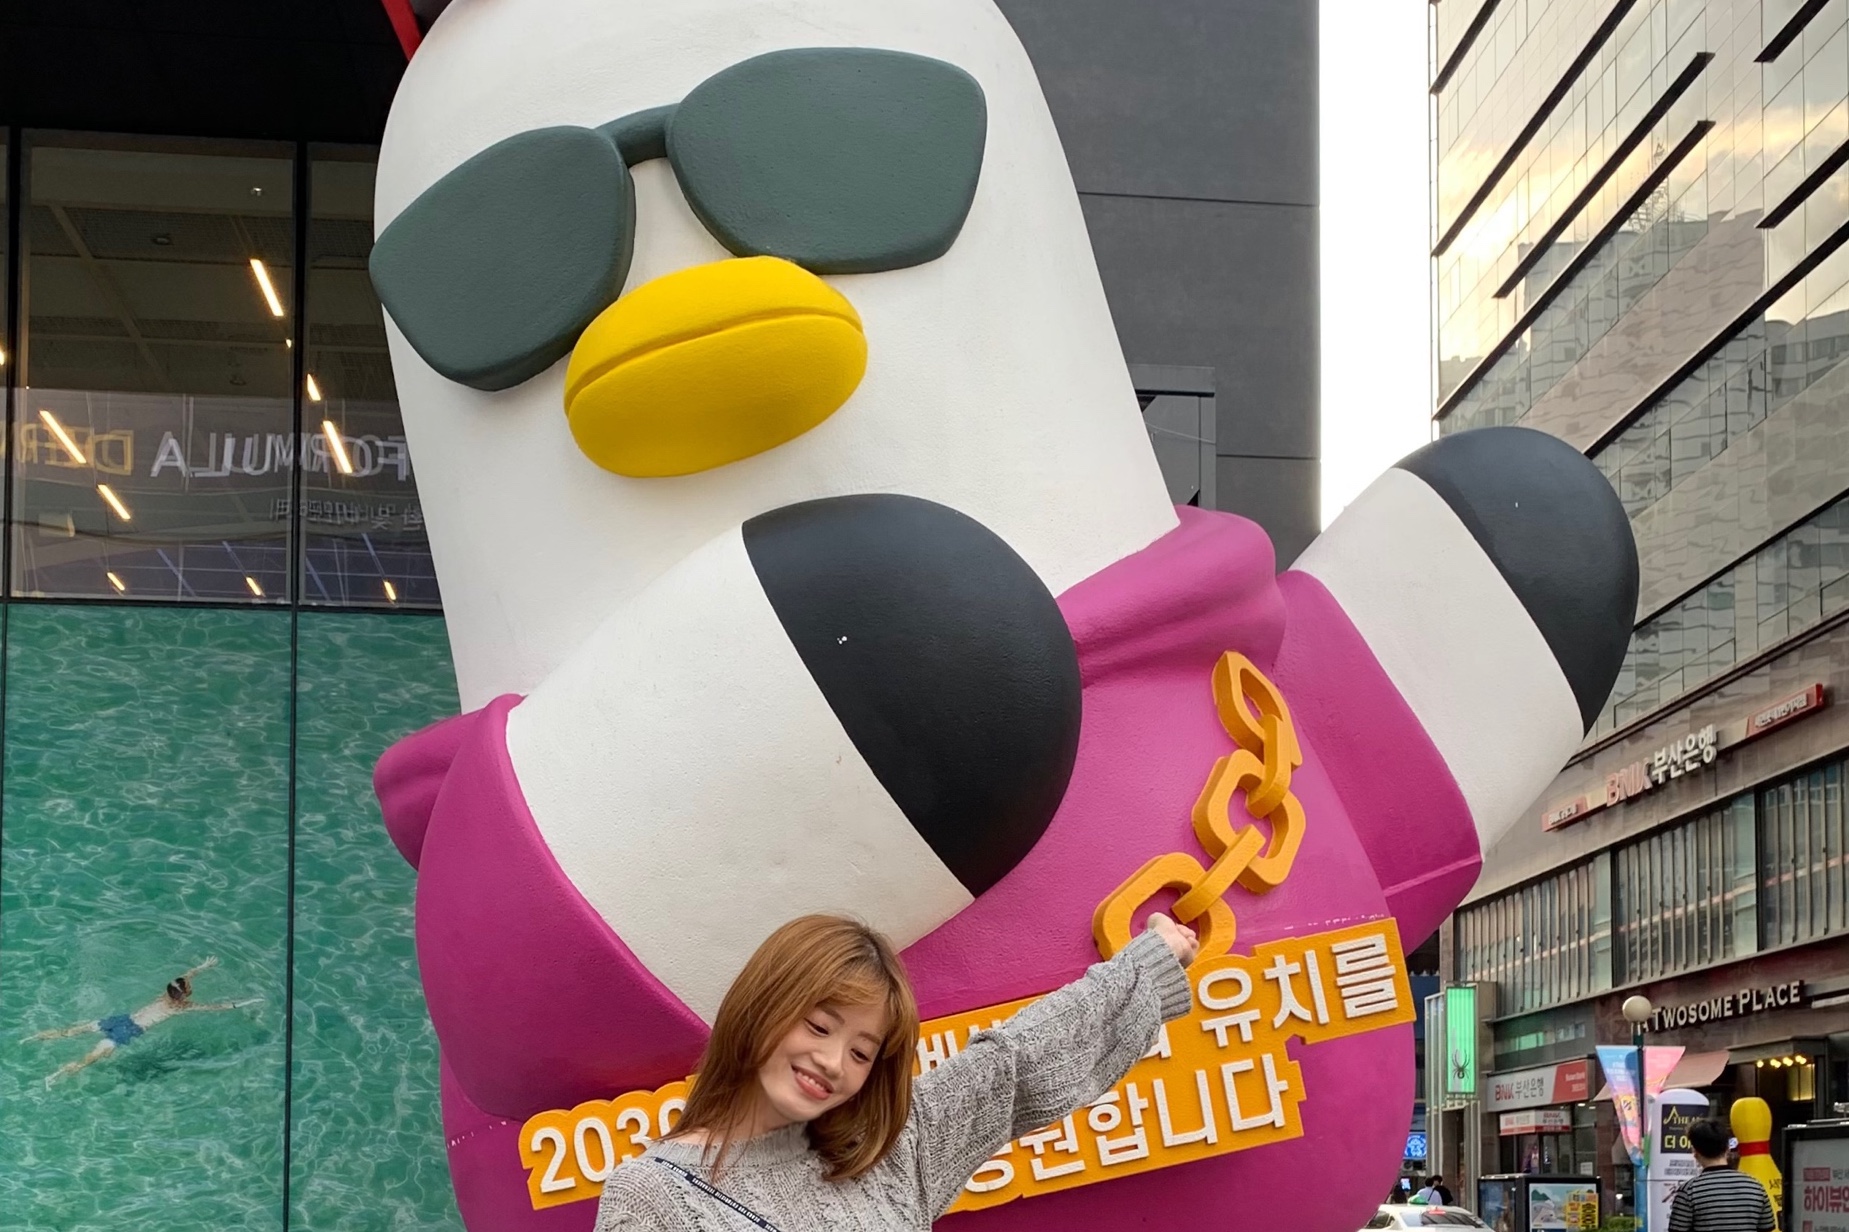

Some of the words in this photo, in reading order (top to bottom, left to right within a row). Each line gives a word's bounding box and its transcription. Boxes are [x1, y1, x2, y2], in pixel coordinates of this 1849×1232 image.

[1606, 757, 1652, 807] BNK
[1652, 724, 1717, 785] 부산은행
[1198, 933, 1398, 1048] 유치를
[1652, 996, 1733, 1031] TWOSOME
[1739, 981, 1801, 1015] PLACE
[1495, 1083, 1514, 1101] BNK
